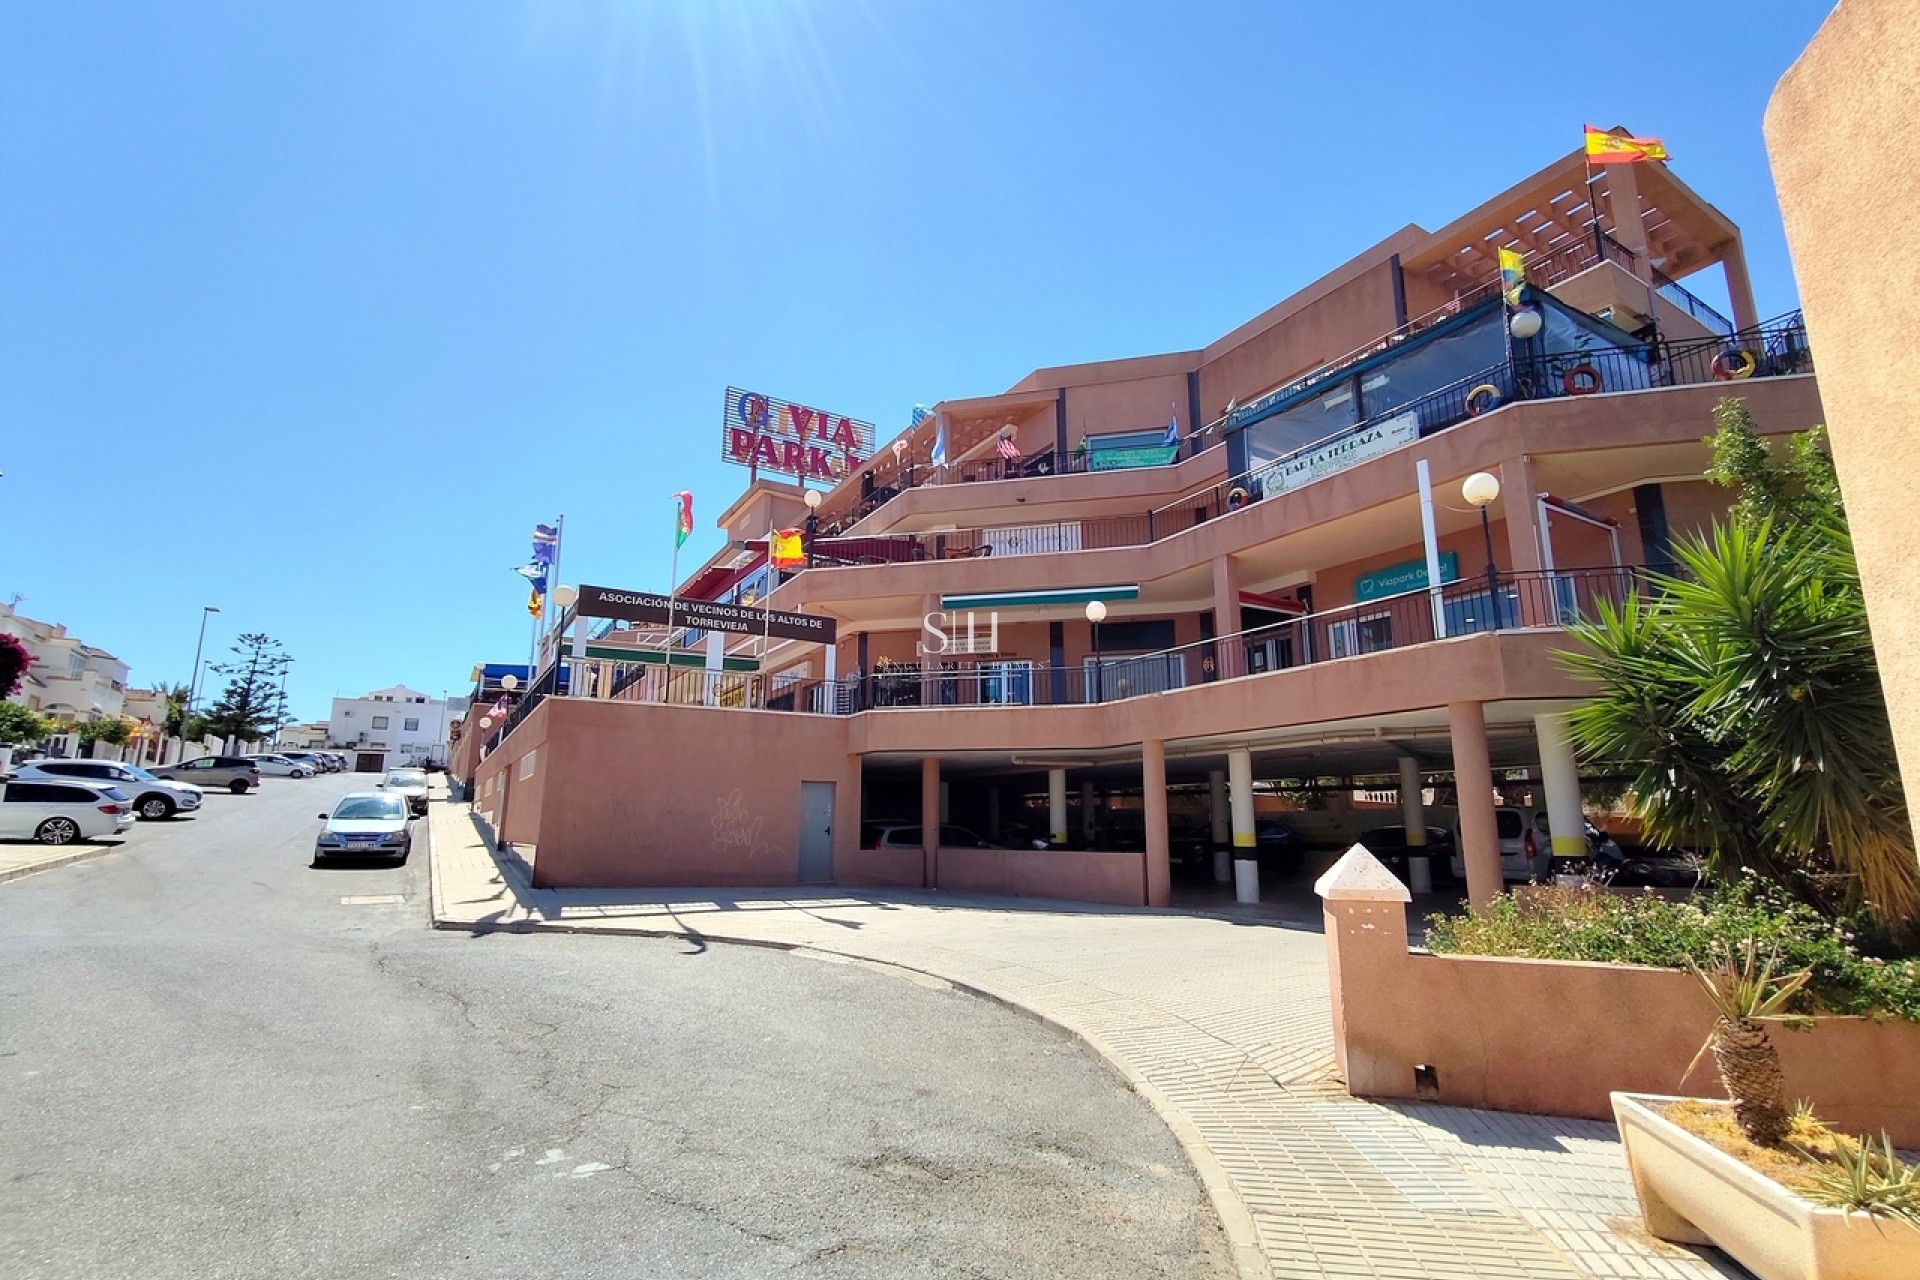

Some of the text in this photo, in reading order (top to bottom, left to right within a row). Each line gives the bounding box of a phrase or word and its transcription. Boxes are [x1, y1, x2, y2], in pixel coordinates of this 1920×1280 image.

[788, 404, 858, 448] VIA
[730, 428, 834, 477] PARK
[1378, 571, 1415, 586] Viapark
[598, 591, 671, 609] ASOCIACIÓN
[674, 601, 689, 611] DE
[691, 603, 739, 617] VECINOS
[740, 609, 755, 620] DE
[777, 615, 808, 627] ALTOS
[809, 618, 823, 629] DE
[685, 615, 748, 632] TORREVIEJA
